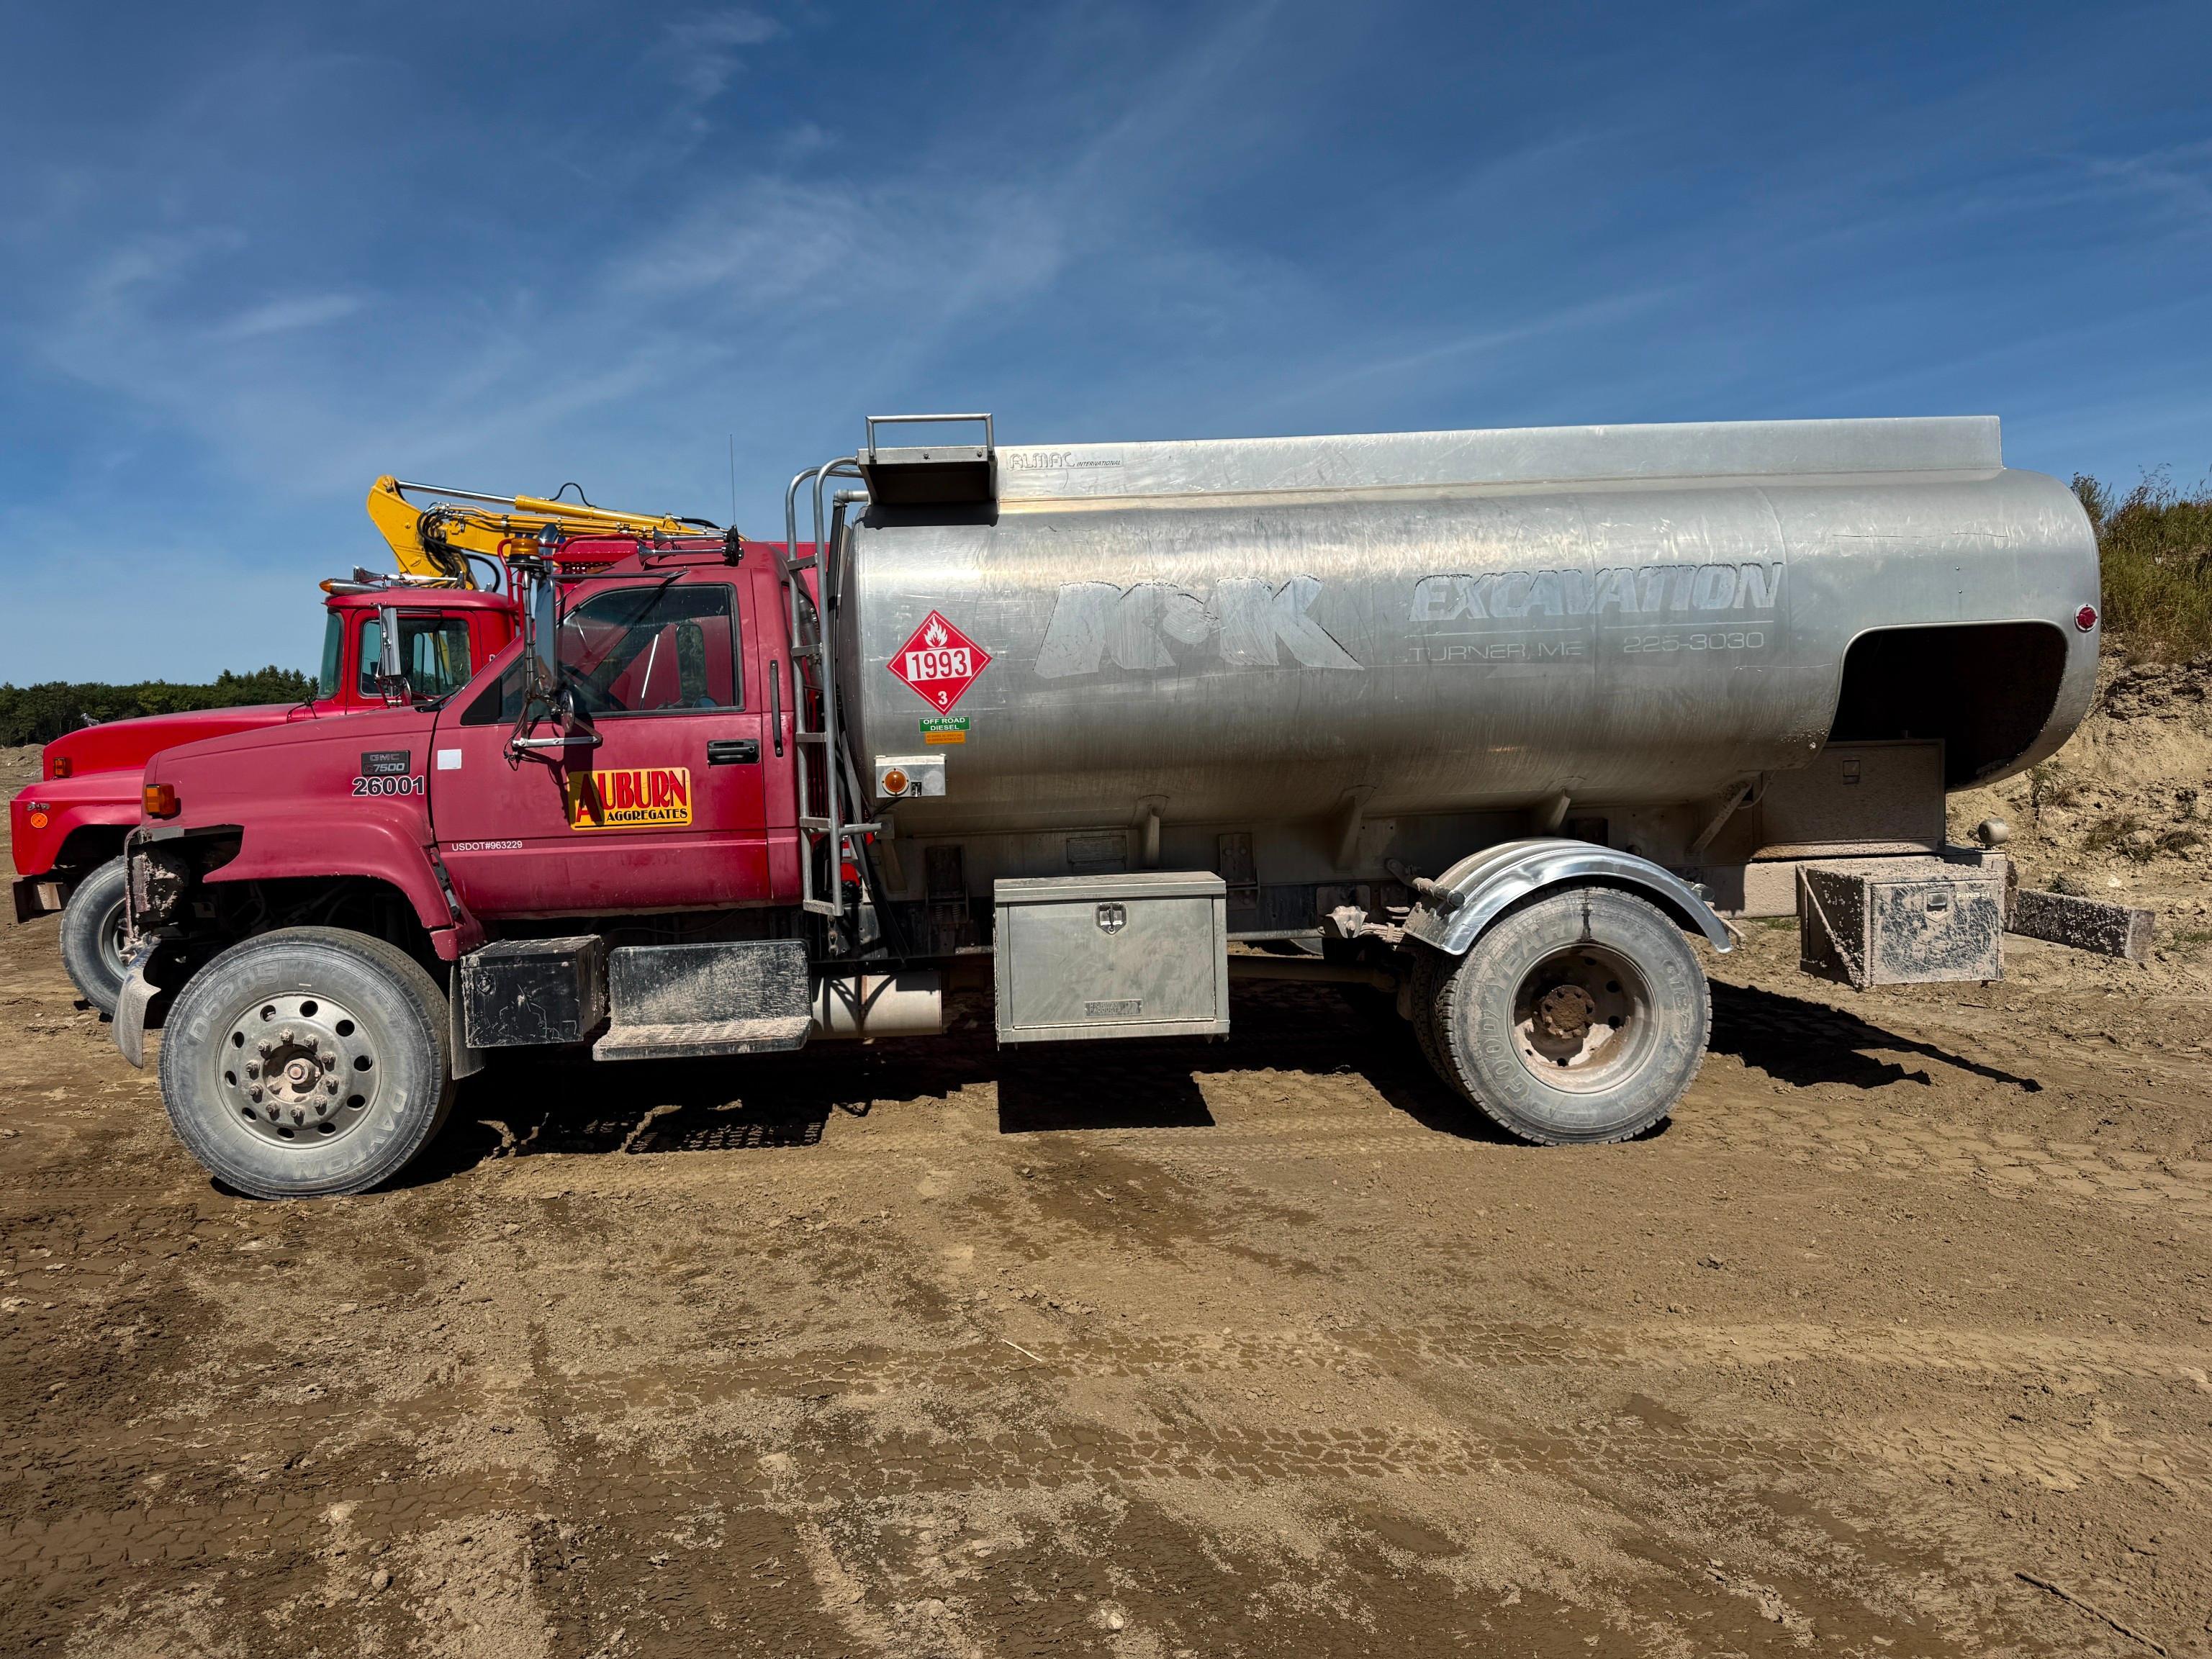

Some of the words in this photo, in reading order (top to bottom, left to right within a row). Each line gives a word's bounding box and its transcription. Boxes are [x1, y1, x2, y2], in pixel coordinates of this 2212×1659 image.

[1009, 451, 1075, 469] ALMAC
[1408, 561, 1784, 621] EXCAVATION
[1538, 640, 1583, 656] ME
[1622, 631, 1765, 653] 225-3030
[911, 650, 967, 679] 1993
[937, 690, 948, 705] 3
[369, 753, 400, 761] GMC
[351, 775, 425, 797] 26001
[576, 769, 687, 823] AUBURN
[606, 808, 688, 821] AGGREGATES
[451, 840, 523, 851] USDOT#963229
